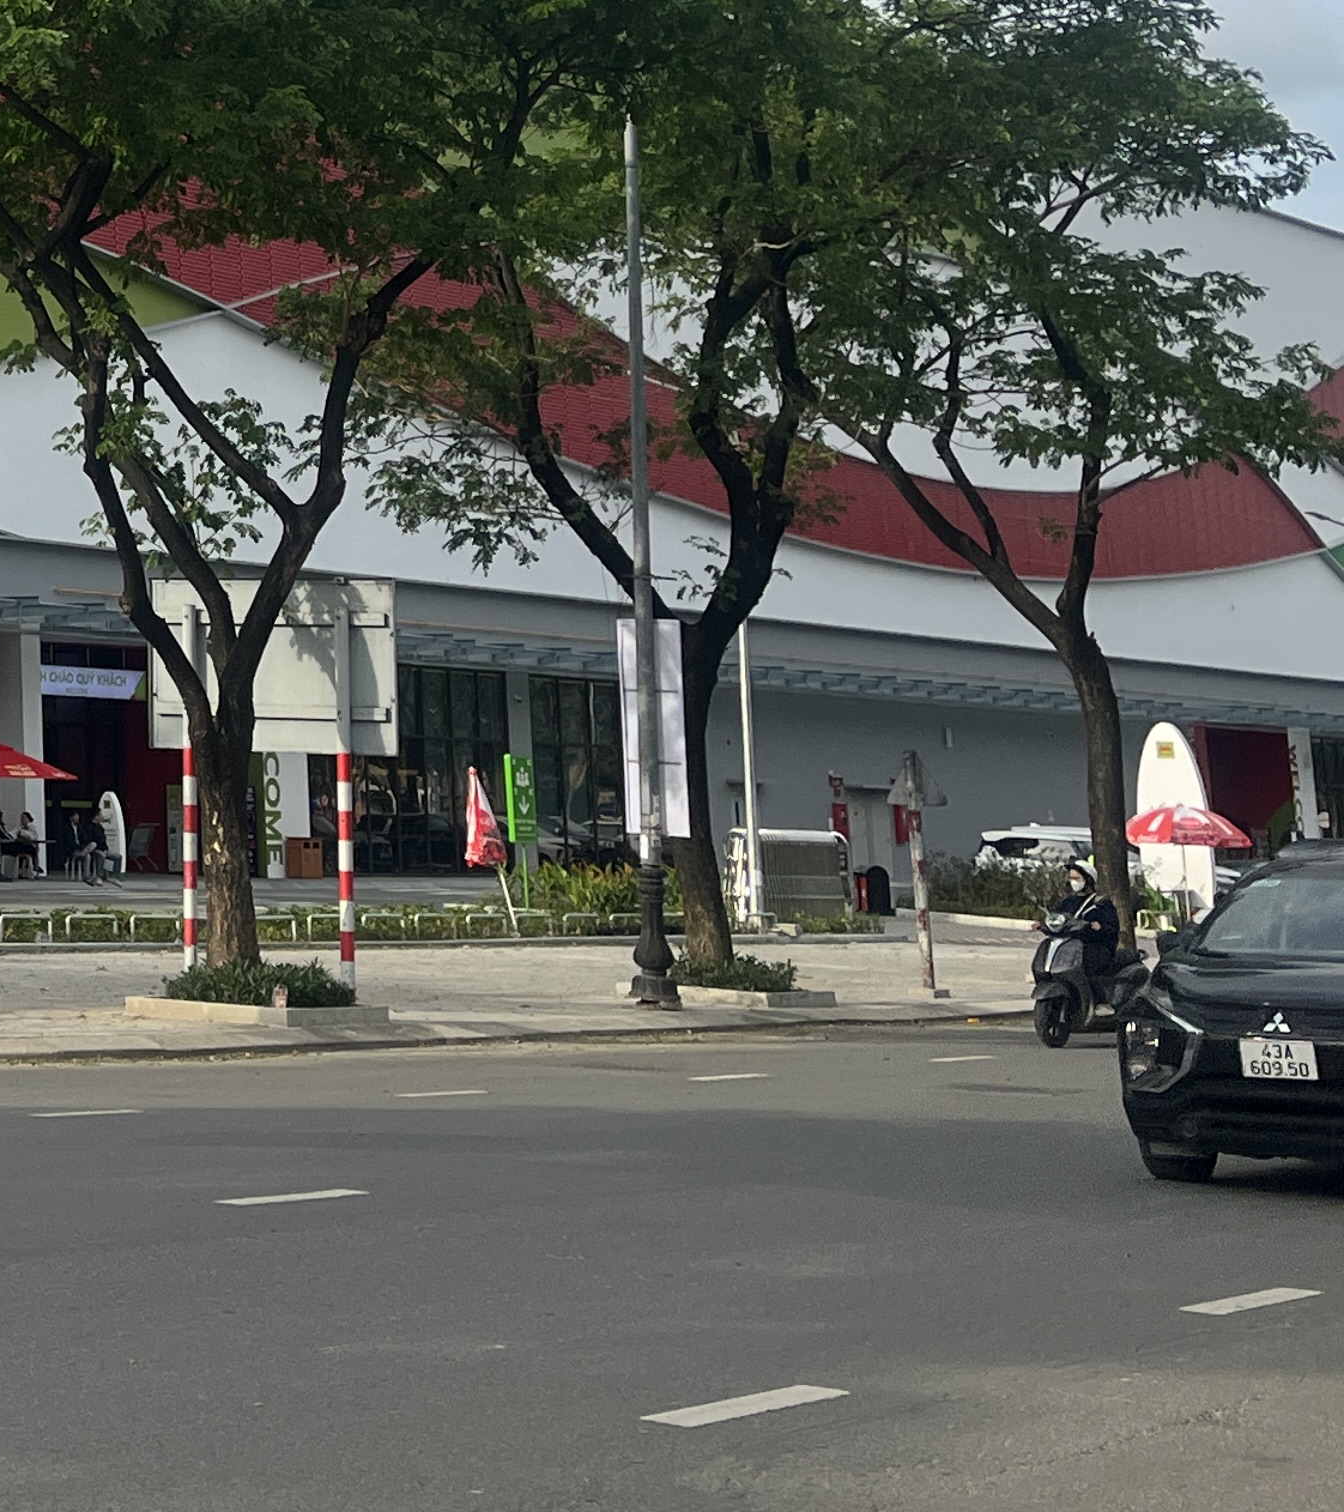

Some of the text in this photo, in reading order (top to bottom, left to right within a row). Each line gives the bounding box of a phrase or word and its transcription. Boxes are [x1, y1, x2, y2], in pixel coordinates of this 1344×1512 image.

[263, 751, 283, 866] COME
[1261, 1044, 1294, 1060] 43A
[1250, 1060, 1310, 1078] 609.50
